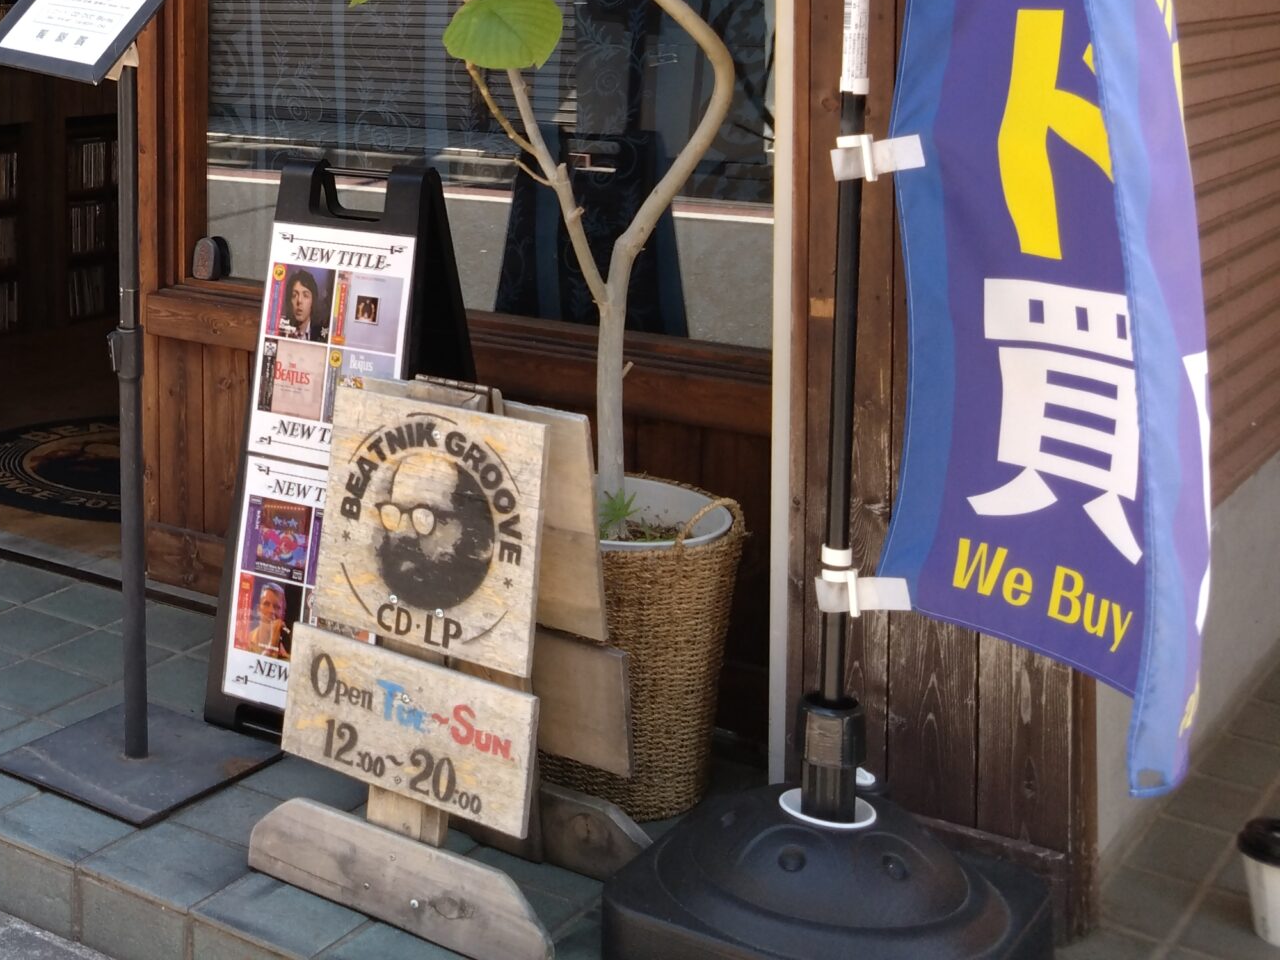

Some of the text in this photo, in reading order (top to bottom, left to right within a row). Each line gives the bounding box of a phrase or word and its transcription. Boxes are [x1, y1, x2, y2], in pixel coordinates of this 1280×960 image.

[274, 360, 311, 386] BEATLES
[340, 420, 523, 567] BEATNIK GROOVE
[952, 537, 1133, 653] We Buy
[310, 651, 374, 714] Open
